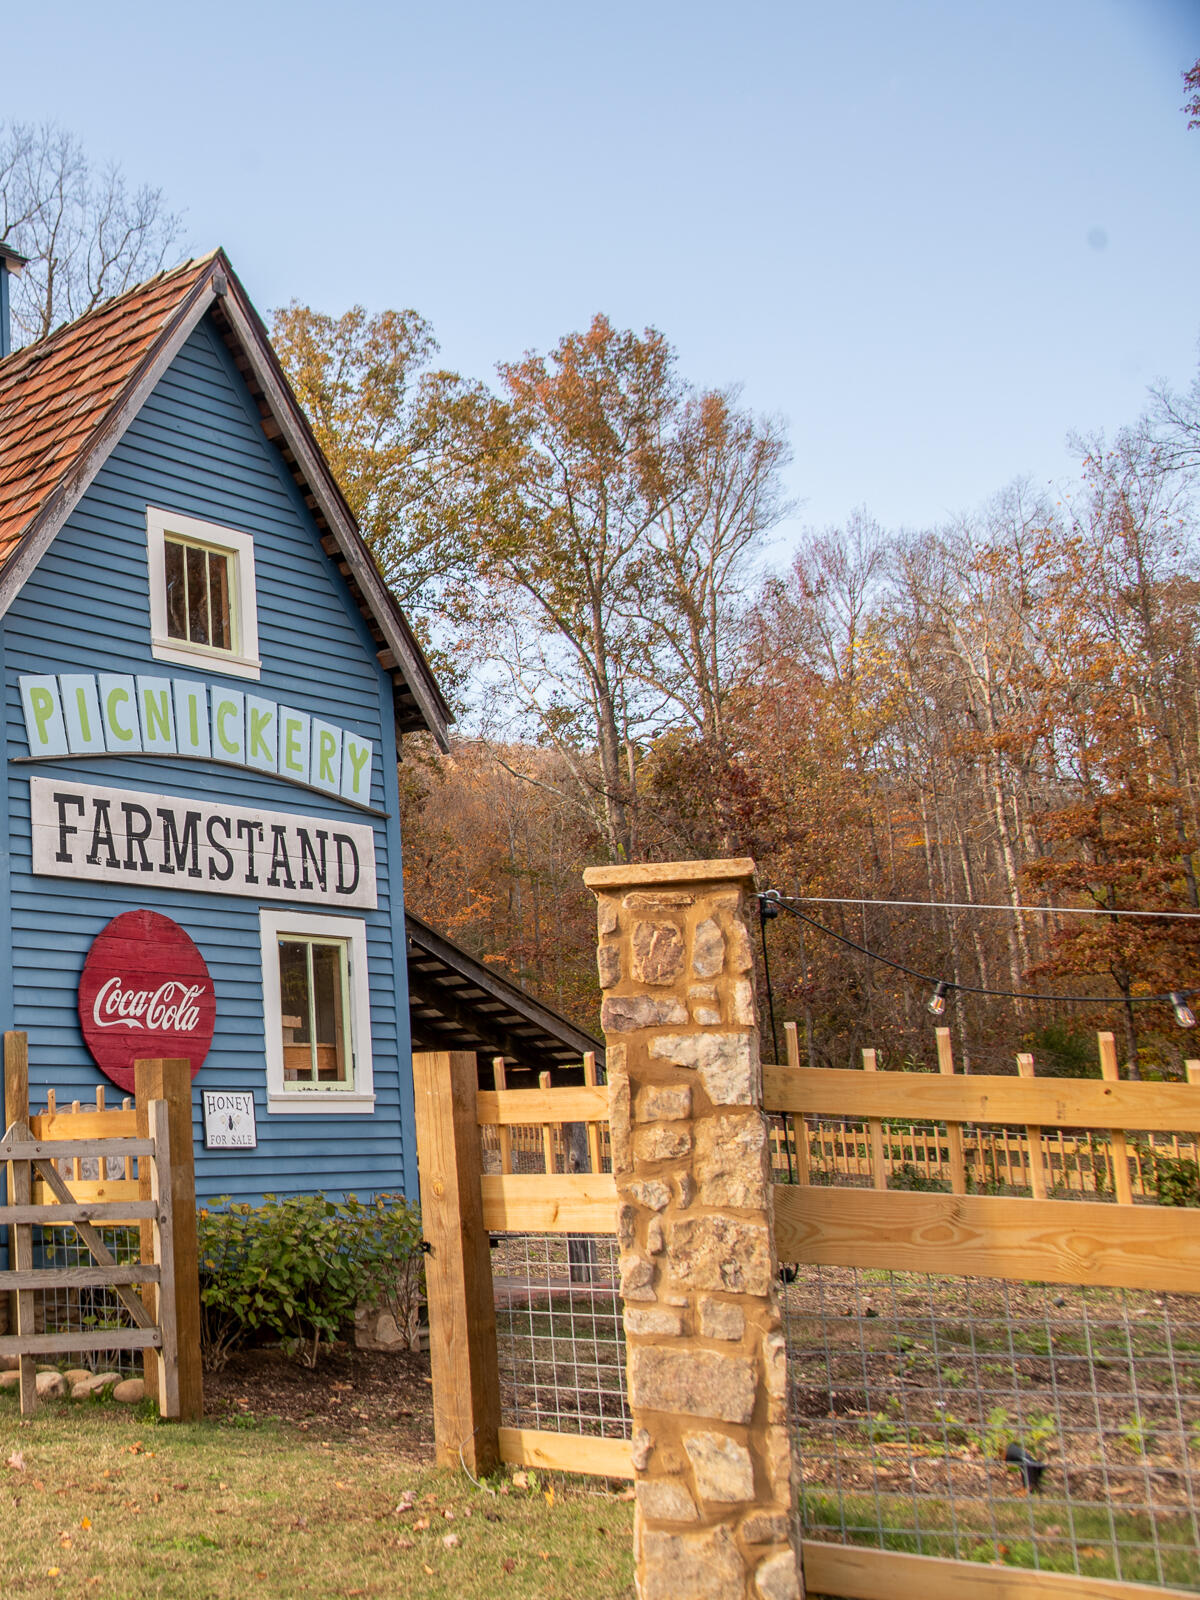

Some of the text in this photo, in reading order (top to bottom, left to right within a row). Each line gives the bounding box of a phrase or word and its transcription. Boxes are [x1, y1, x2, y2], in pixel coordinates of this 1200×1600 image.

[29, 687, 370, 794] PICNICKERY
[53, 792, 360, 895] FARMSTAND
[206, 1095, 250, 1116] HONEY
[210, 1134, 253, 1145] FOR SALE
